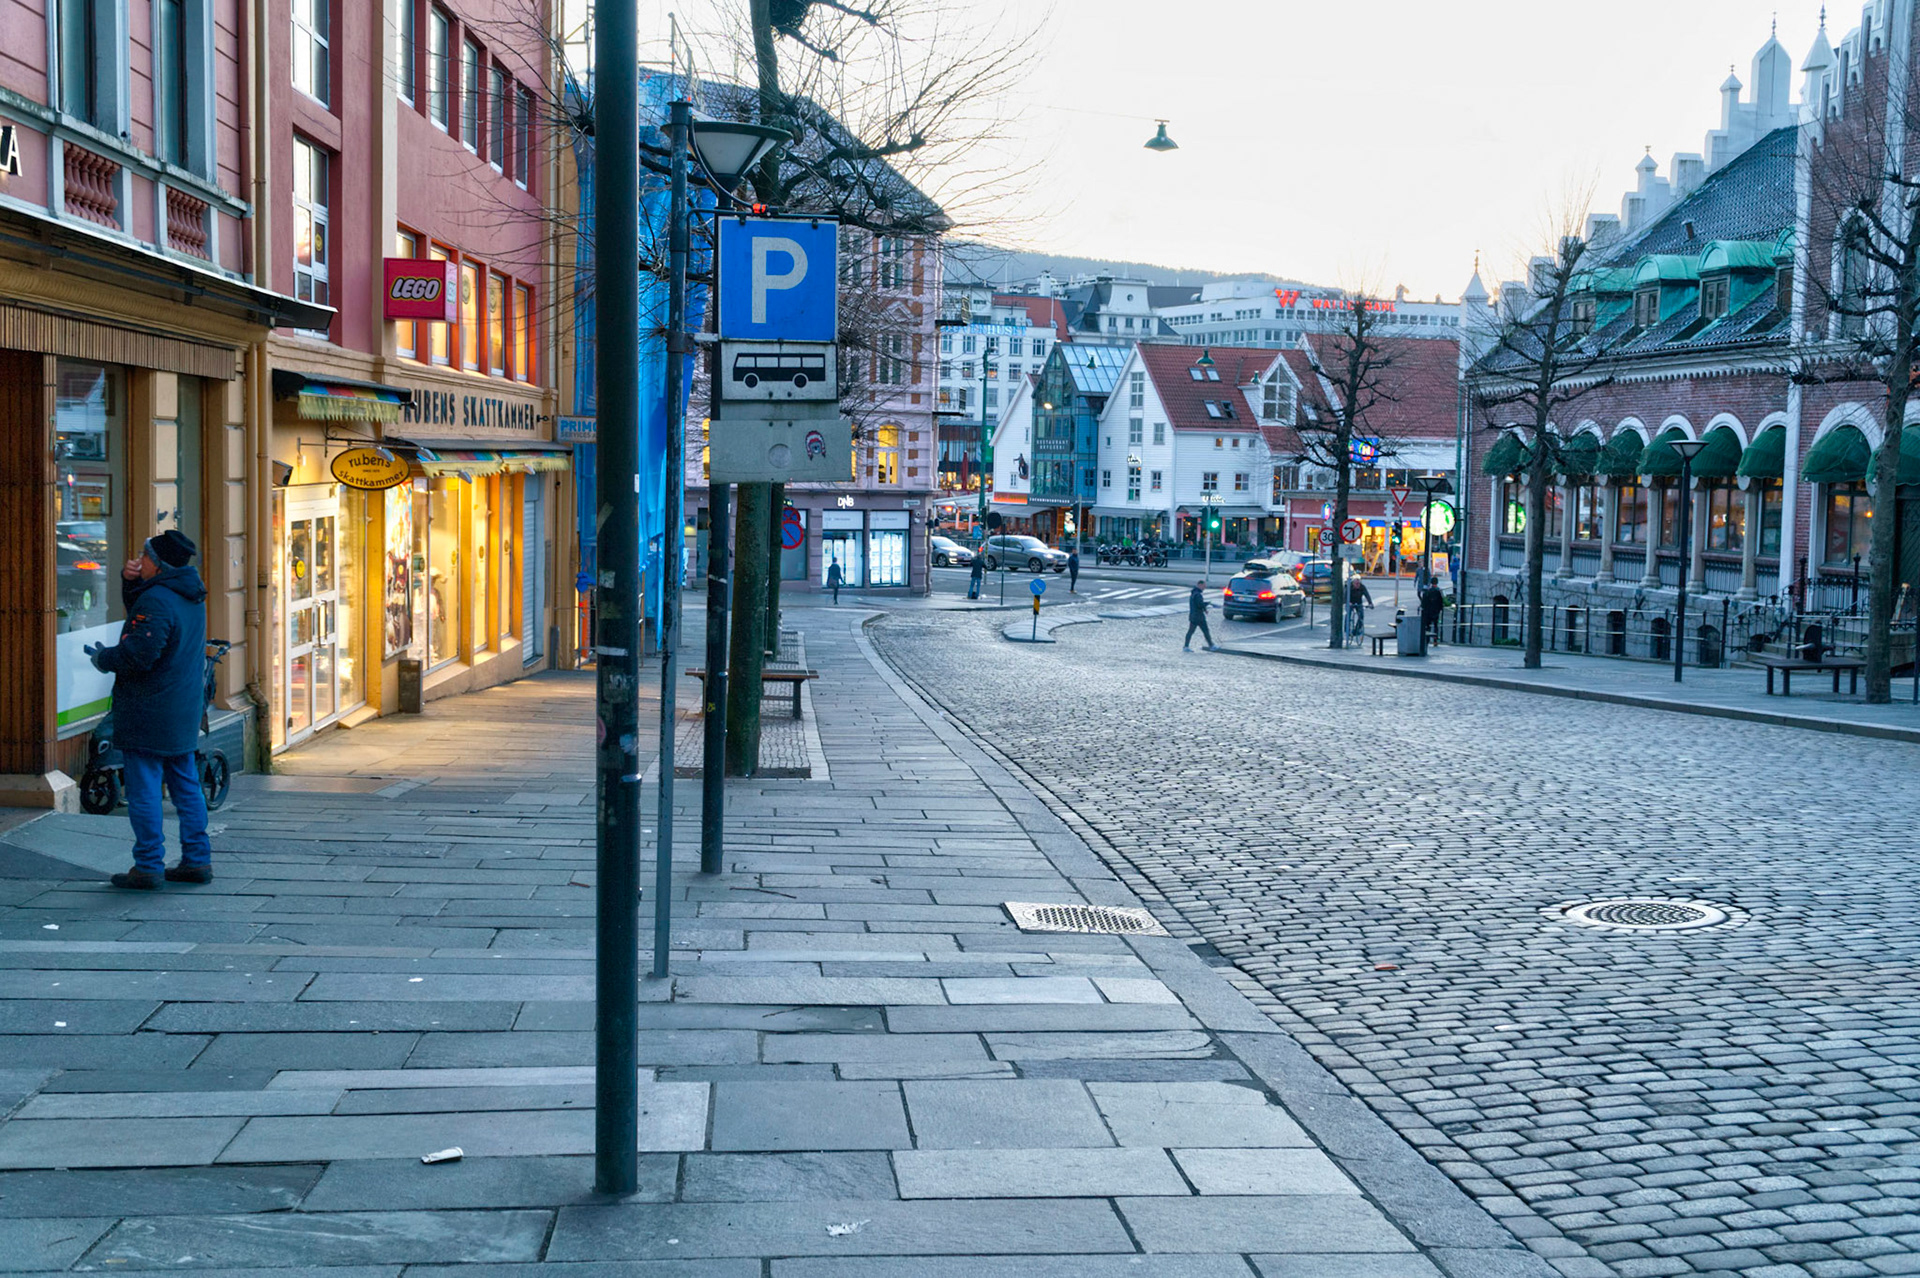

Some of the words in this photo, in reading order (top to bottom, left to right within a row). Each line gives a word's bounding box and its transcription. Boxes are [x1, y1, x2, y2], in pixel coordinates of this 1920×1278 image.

[392, 278, 440, 300] LEGO
[751, 236, 808, 324] P
[463, 394, 535, 431] SKATTKAMMER
[339, 470, 404, 487] skattkammer
[837, 494, 855, 509] DNB
[1322, 532, 1334, 541] 30
